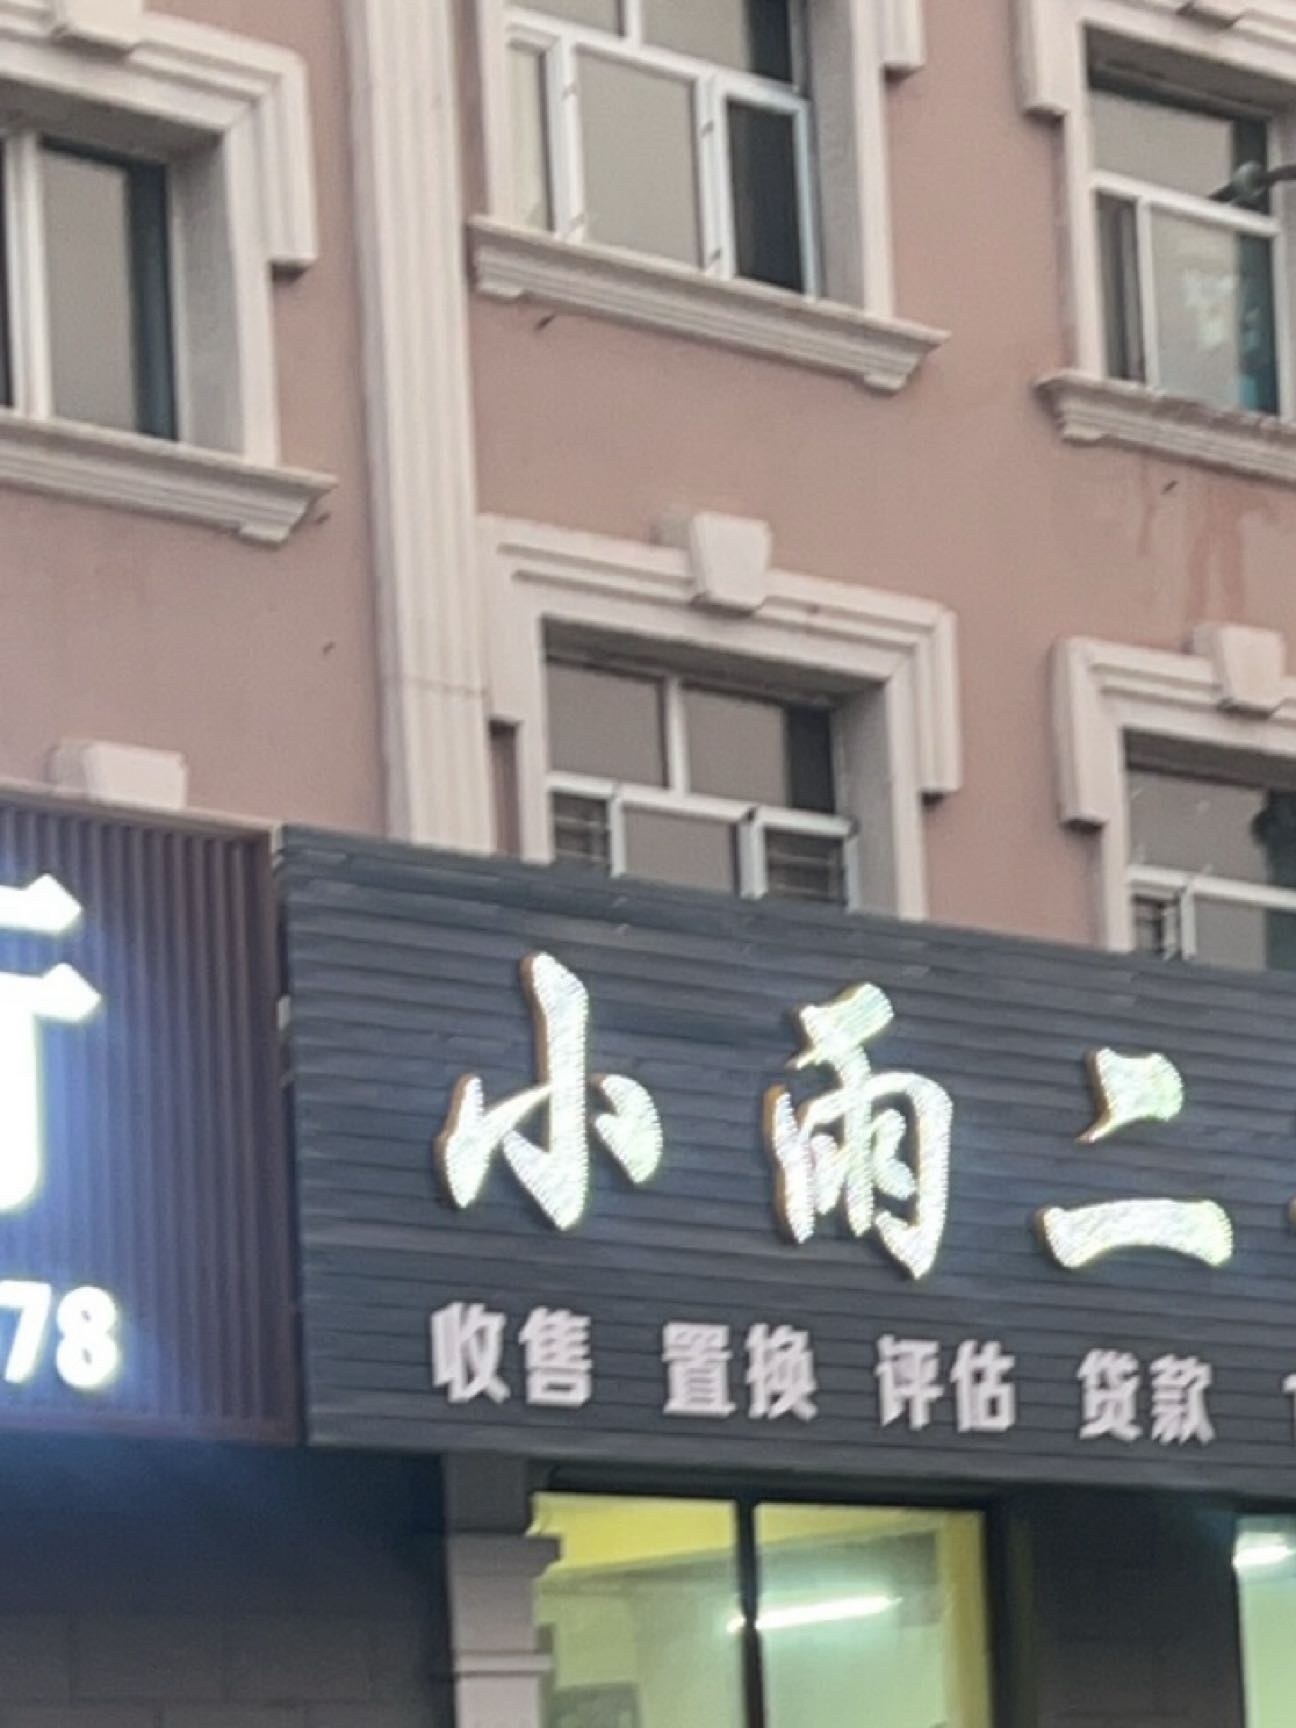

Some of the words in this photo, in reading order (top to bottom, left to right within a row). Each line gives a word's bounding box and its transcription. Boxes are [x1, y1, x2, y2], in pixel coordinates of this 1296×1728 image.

[431, 1302, 592, 1407] 收售
[662, 1323, 817, 1421] 置换
[875, 1333, 1016, 1432] 评估
[1078, 1348, 1215, 1445] 贷款
